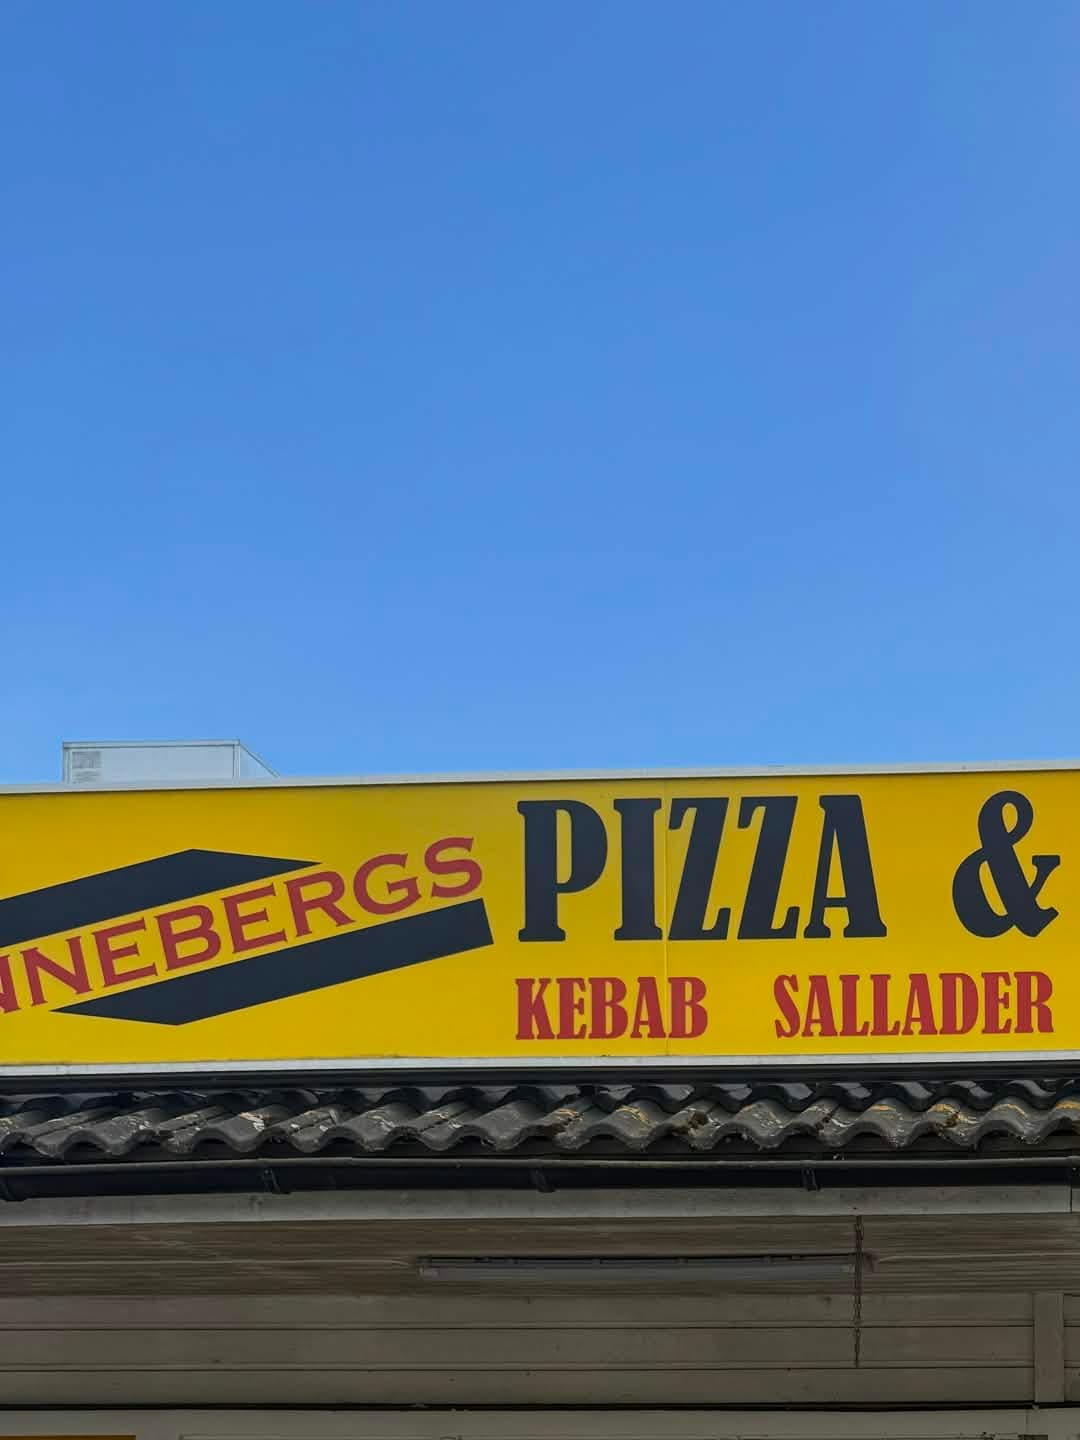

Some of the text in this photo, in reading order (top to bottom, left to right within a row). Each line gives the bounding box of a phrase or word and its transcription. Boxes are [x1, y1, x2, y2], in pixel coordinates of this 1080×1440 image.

[517, 795, 888, 943] PIZZA
[951, 790, 1061, 939] &
[515, 976, 708, 1041] KEBAB
[773, 971, 1055, 1039] SALLADER
